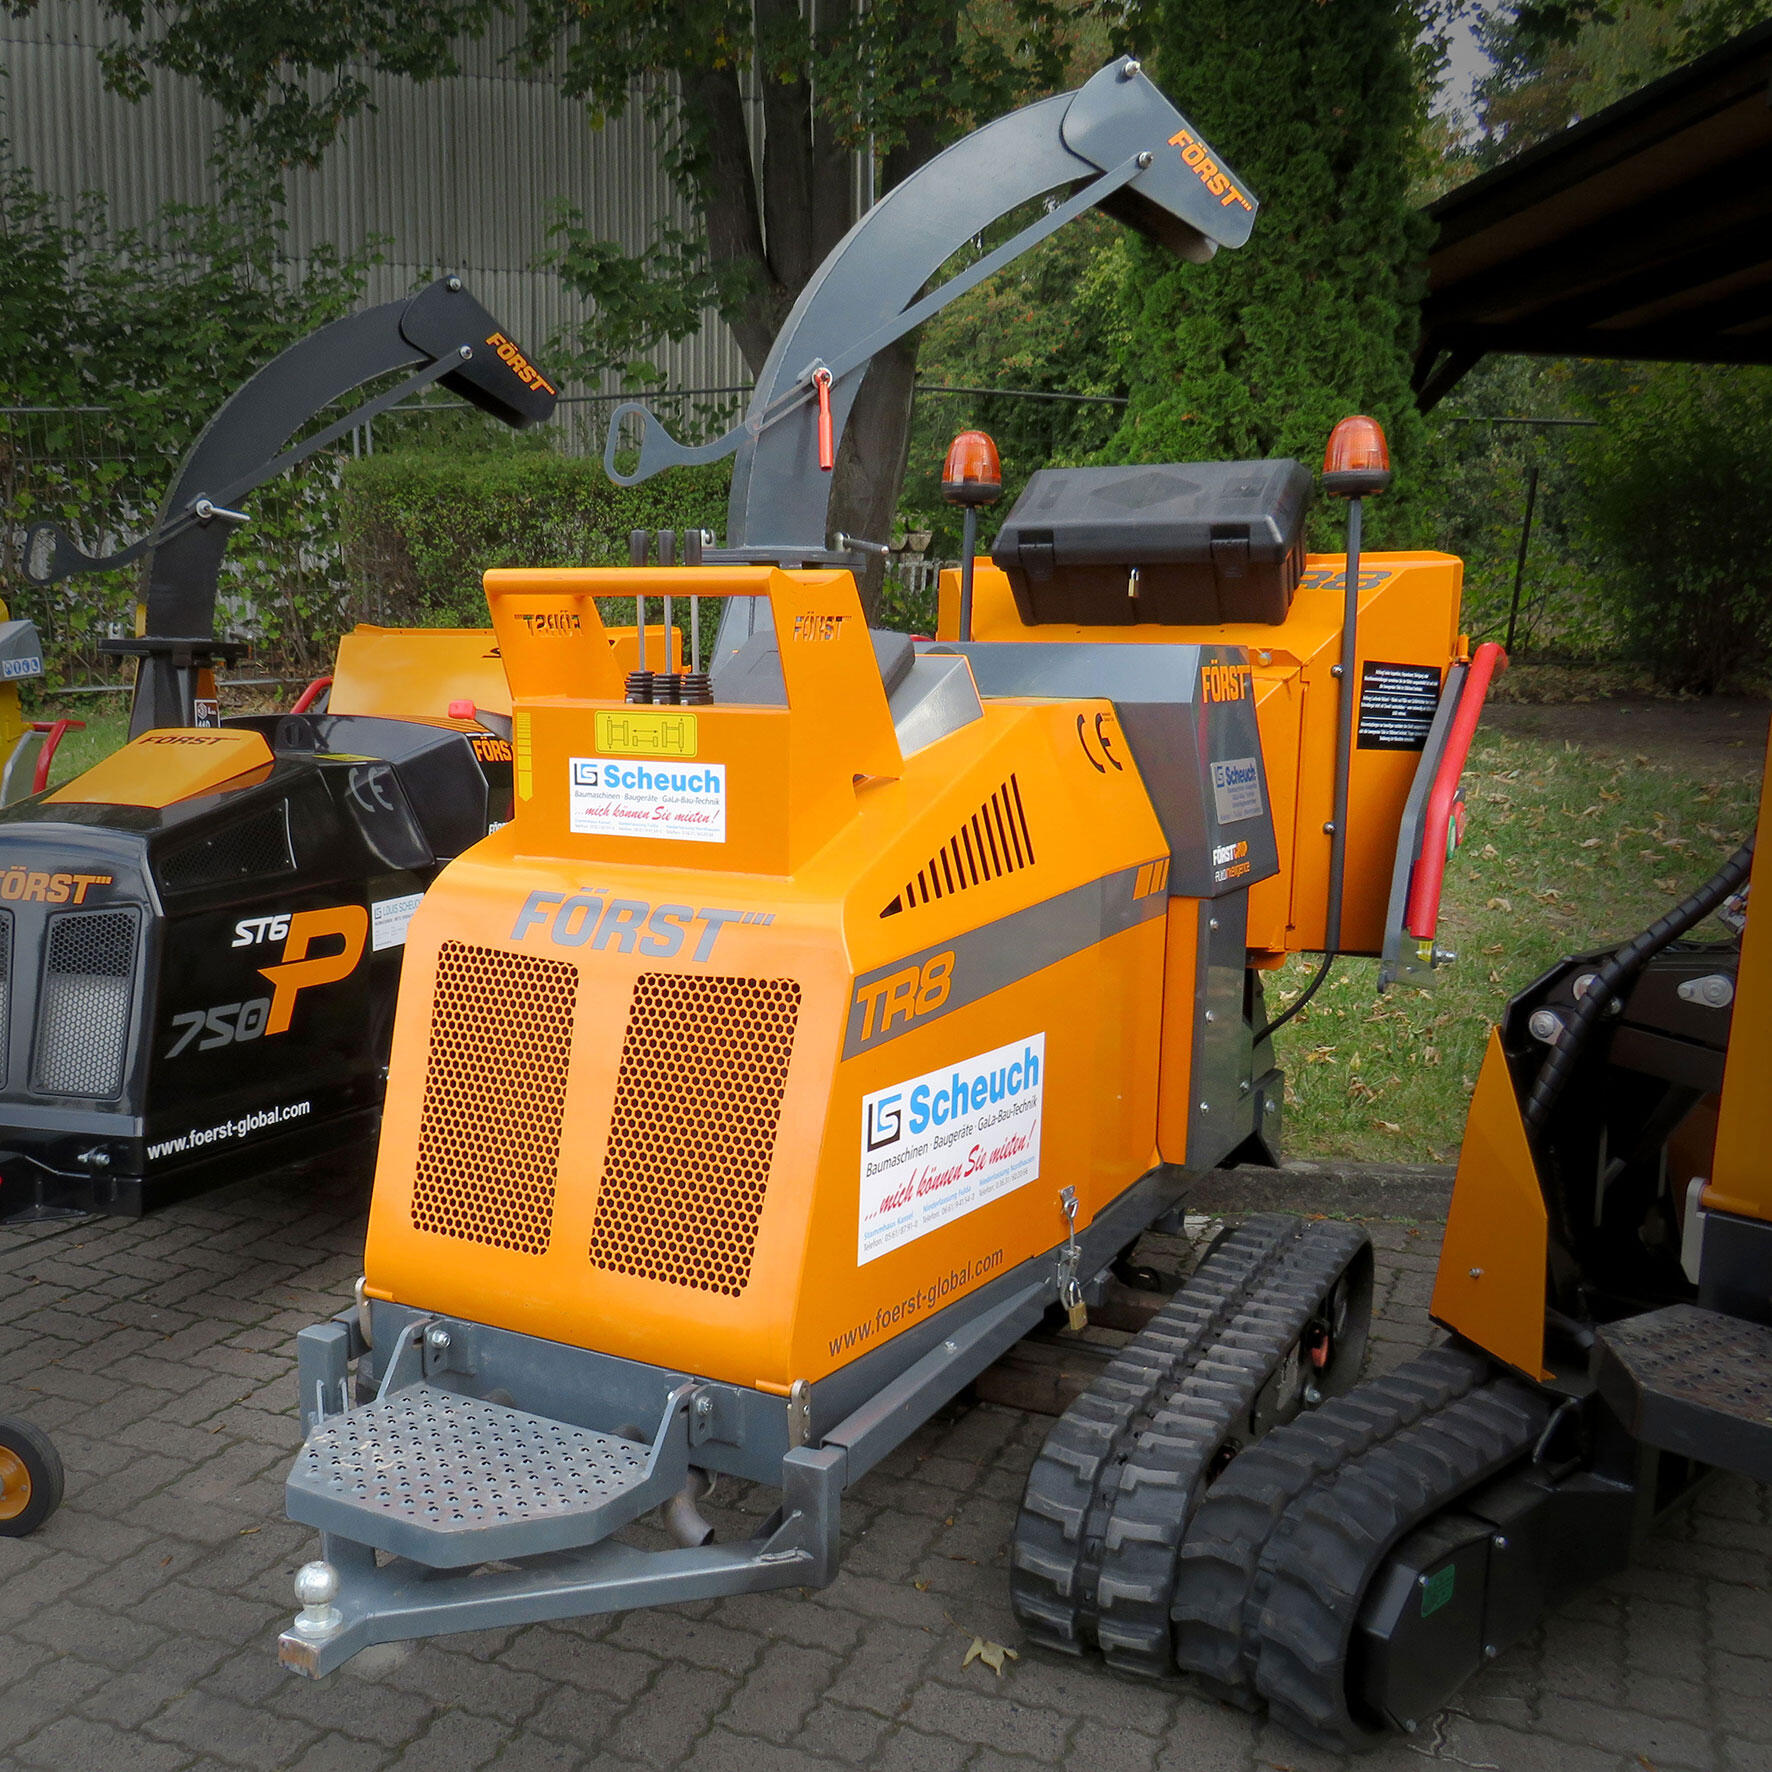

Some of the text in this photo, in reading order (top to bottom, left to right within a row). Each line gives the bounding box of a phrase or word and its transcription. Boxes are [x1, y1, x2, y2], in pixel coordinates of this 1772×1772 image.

[1167, 128, 1253, 212] FÖRST
[485, 332, 557, 396] FÖRST
[793, 610, 852, 642] FÖRST
[1201, 659, 1251, 704] FÖRST
[471, 736, 513, 762] FÖRS
[1225, 764, 1257, 786] Scheuch
[574, 789, 621, 800] Baumaschinen
[623, 792, 659, 803] Baugeräte
[603, 764, 721, 794] Scheuch
[612, 802, 650, 820] können
[651, 805, 671, 821] Sie
[0, 865, 113, 905] ÖRST
[510, 886, 776, 963] FÖRST
[856, 950, 956, 1042] TR8
[164, 997, 271, 1060] 750
[909, 1046, 1039, 1135] Scheuch
[147, 1100, 311, 1161] www.foerst-global.com
[866, 1095, 1038, 1178] Baumaschinen Baugeräte GaLa-Bau-Technik
[916, 1164, 963, 1198] können
[963, 1143, 988, 1178] Sie
[828, 1248, 1004, 1358] www.foerst-global.com
